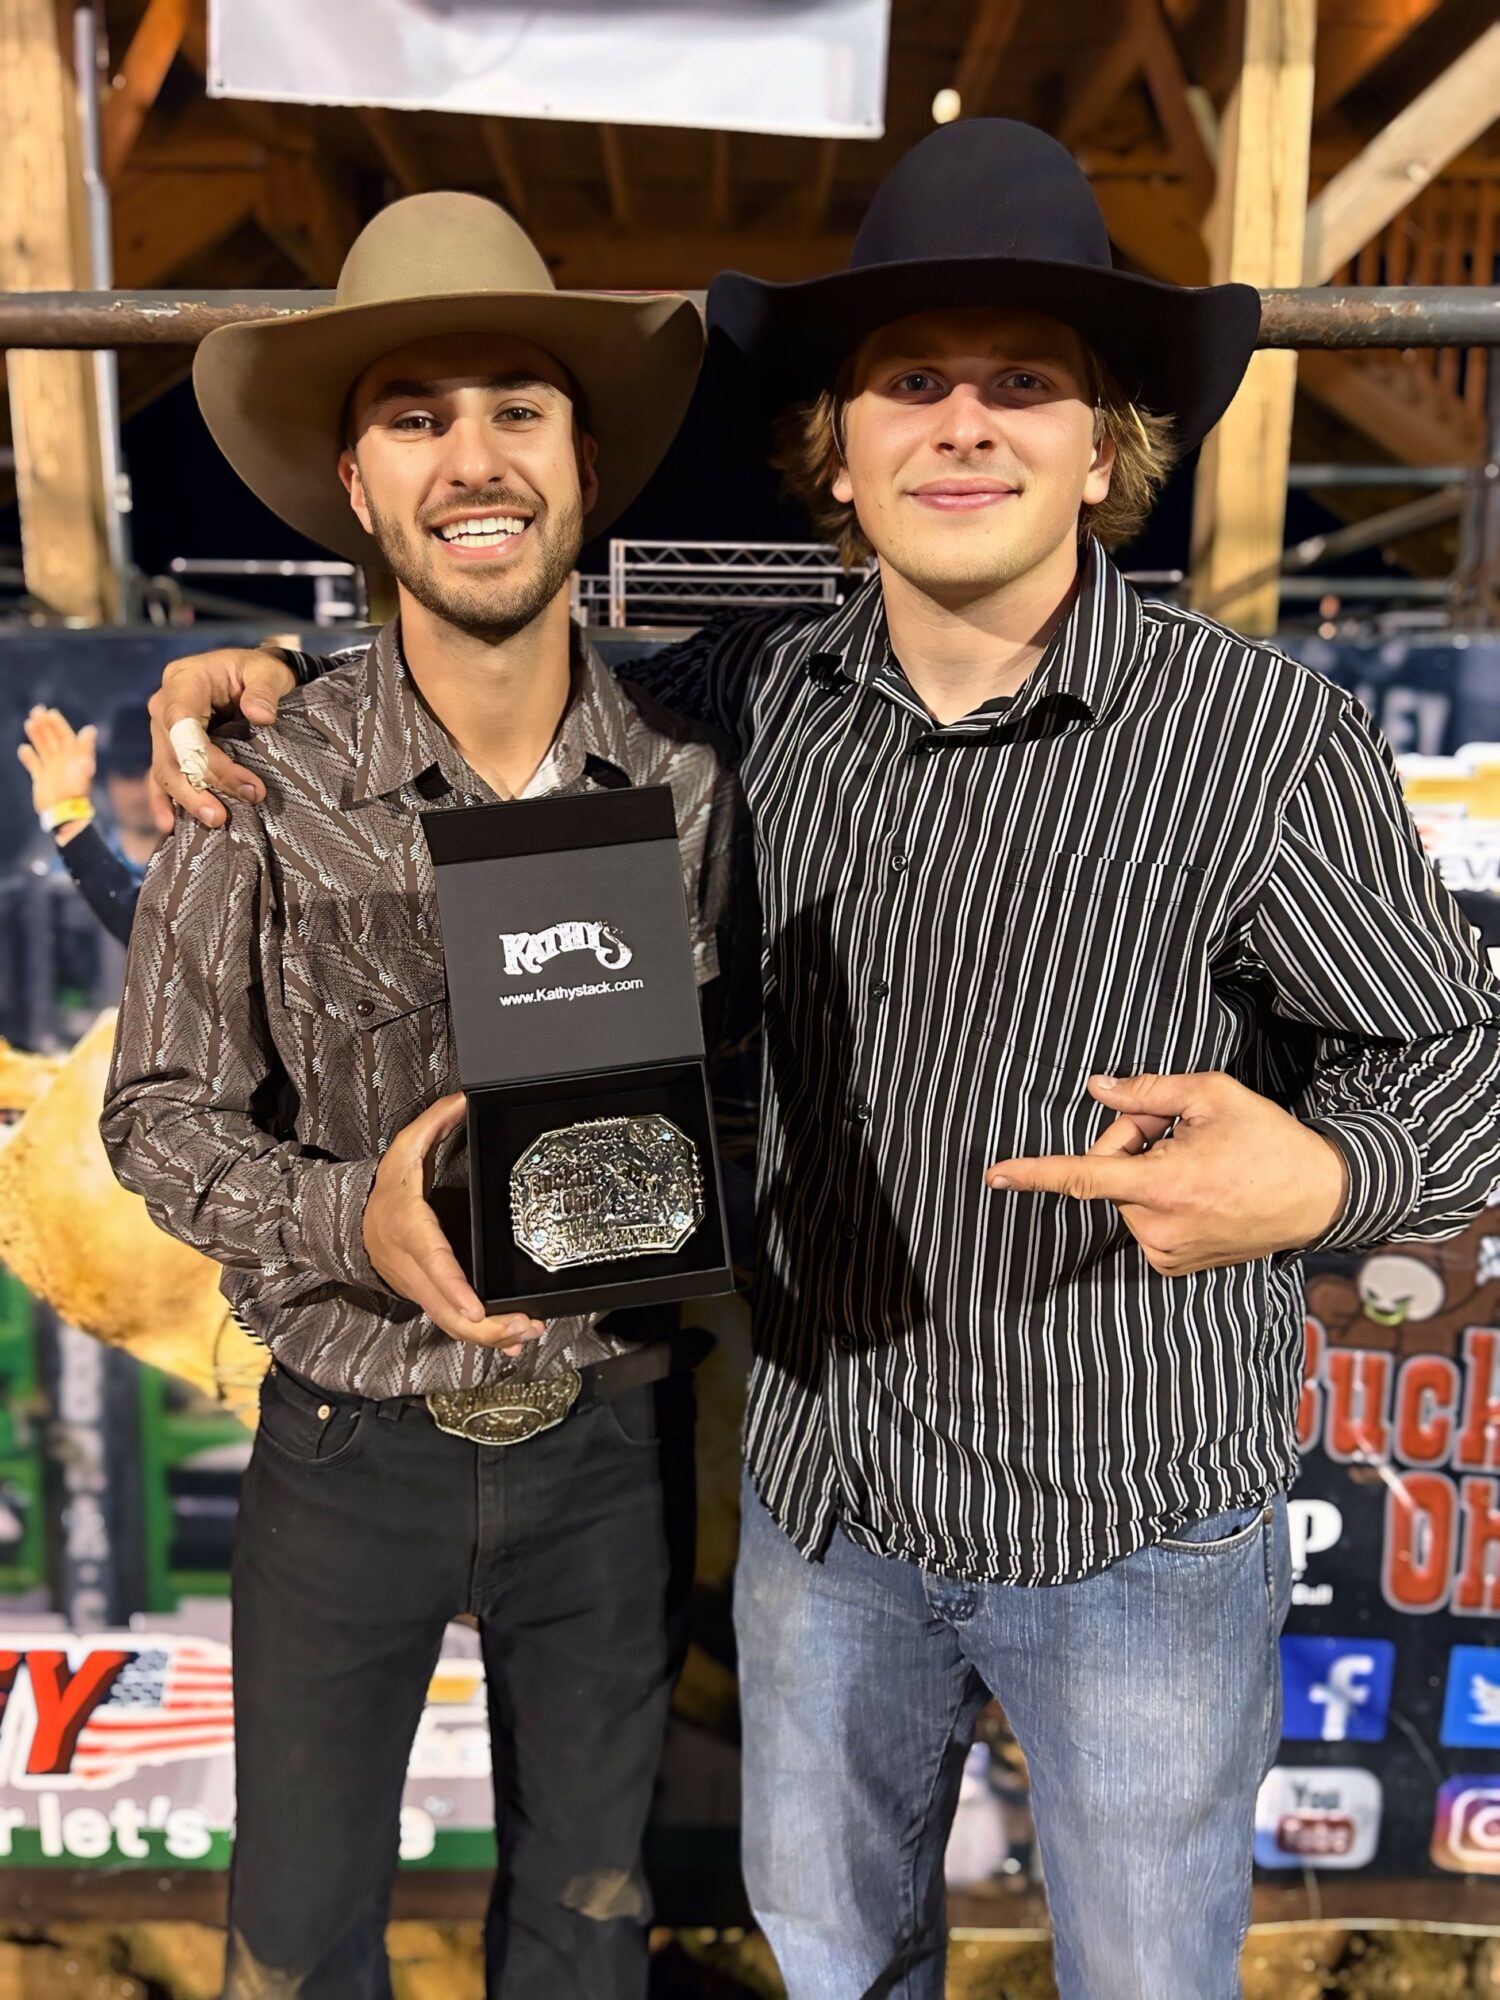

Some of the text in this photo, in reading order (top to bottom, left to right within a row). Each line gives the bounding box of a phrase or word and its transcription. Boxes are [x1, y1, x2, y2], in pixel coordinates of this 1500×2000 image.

[1433, 857, 1500, 881] EV
[499, 978, 645, 1006] www.Kathystack.com
[38, 1791, 213, 1860] let's
